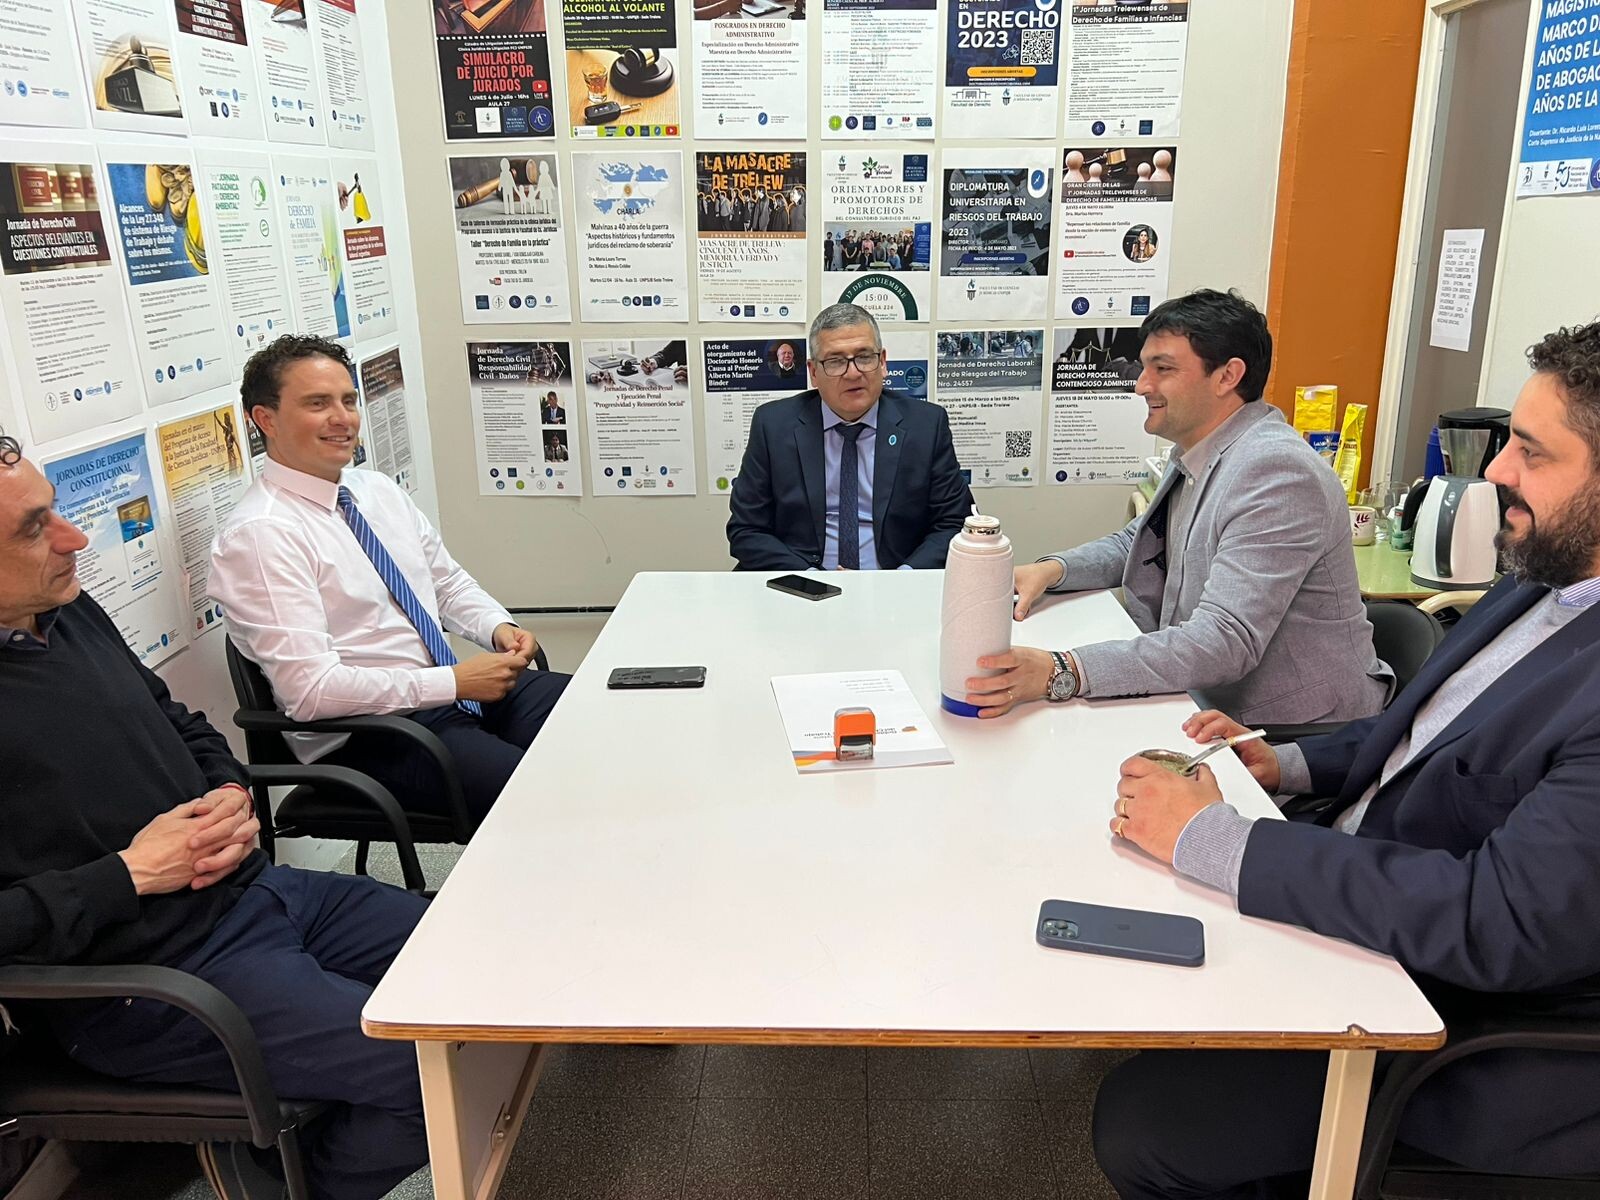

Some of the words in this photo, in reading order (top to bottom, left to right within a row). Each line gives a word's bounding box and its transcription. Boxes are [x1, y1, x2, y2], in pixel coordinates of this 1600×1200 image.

[564, 4, 606, 13] ALCOHOL
[623, 3, 665, 12] VOLANTE
[958, 11, 1059, 28] DERECHO
[1542, 17, 1588, 43] MARCO
[1589, 14, 1600, 32] D
[958, 31, 1008, 48] 2023
[463, 51, 525, 65] SIMULACRO
[1538, 44, 1572, 68] AÑOS
[1574, 41, 1591, 60] DE
[1593, 39, 1600, 57] L
[457, 66, 470, 79] DE
[474, 66, 508, 79] JUICIO
[511, 65, 534, 77] POR
[473, 79, 521, 92] JURADOS
[1536, 73, 1552, 91] DE
[1532, 91, 1564, 114] AÑOS
[1567, 91, 1582, 110] DE
[1584, 89, 1598, 108] LA
[704, 154, 723, 172] LA
[726, 152, 791, 173] MASACRE
[712, 173, 728, 189] DE
[732, 171, 784, 190] TRELEW
[950, 183, 1009, 191] DIPLOMATURA
[831, 185, 915, 194] ORIENTADORES
[918, 185, 925, 193] Y
[833, 196, 906, 204] PROMOTORES
[909, 196, 923, 204] DE
[950, 198, 1012, 206] UNIVERSITARIA
[848, 207, 905, 215] DERECHOS
[949, 213, 984, 221] RIESGOS
[1005, 212, 1042, 220] TRABAJO
[7, 219, 31, 230] Jornada
[32, 219, 39, 229] de
[40, 218, 63, 228] Derecho
[63, 217, 76, 227] Civil
[121, 216, 128, 224] de
[11, 234, 44, 247] ASPECTOS
[45, 232, 85, 245] RELEVANTES
[85, 231, 94, 242] EN
[13, 247, 50, 261] CUESTIONES
[51, 244, 98, 258] CONTRACTUALES
[852, 282, 863, 292] DE
[864, 277, 907, 298] NOVIEMBRE
[479, 364, 532, 372] Responsabilidad
[56, 461, 95, 486] JORNADAS
[96, 457, 106, 469] DE
[107, 446, 140, 465] DERECHO
[70, 462, 133, 492] CONSTITUCIONAL
